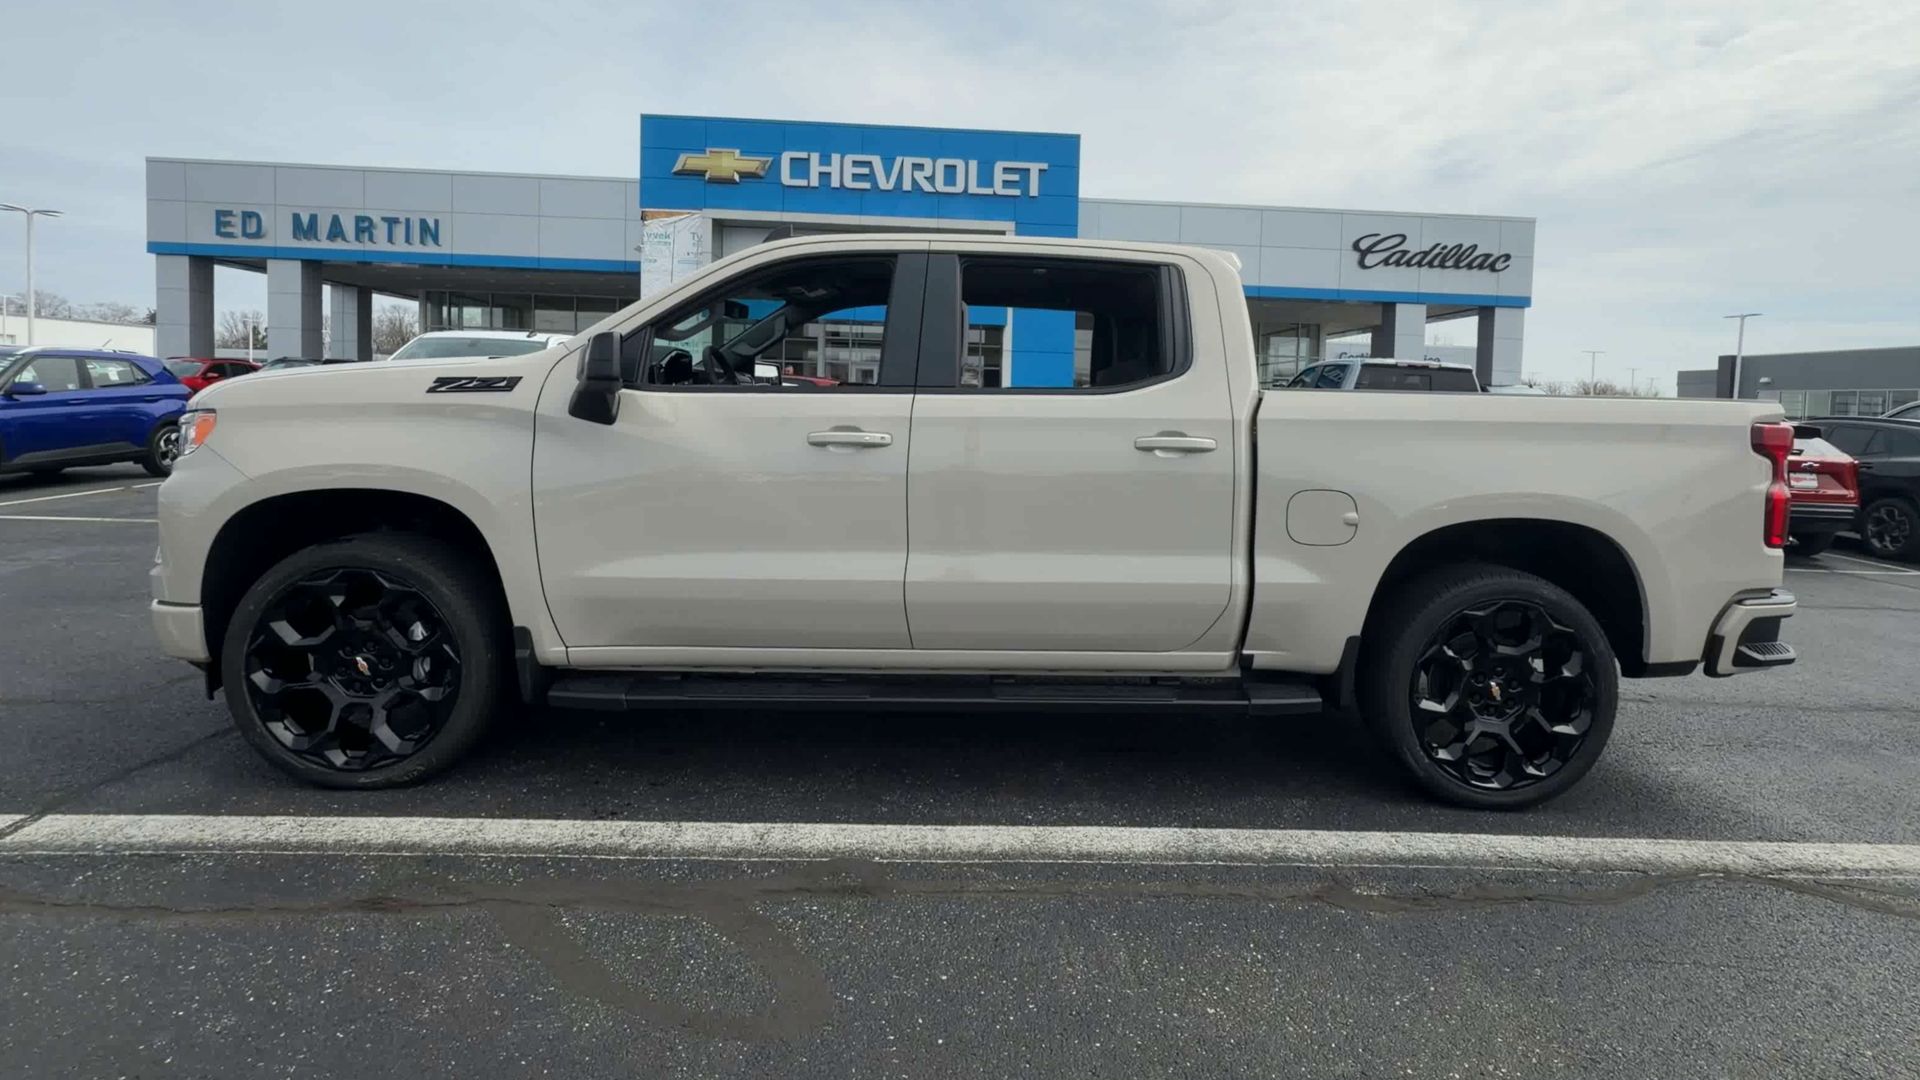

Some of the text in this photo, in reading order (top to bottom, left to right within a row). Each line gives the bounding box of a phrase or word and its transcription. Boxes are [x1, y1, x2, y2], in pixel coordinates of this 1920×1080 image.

[780, 151, 1049, 197] CHEVROLET
[215, 209, 441, 246] ED MARTIN
[643, 231, 671, 241] yvek
[1352, 233, 1511, 272] Cadillac
[425, 376, 523, 393] Z71
